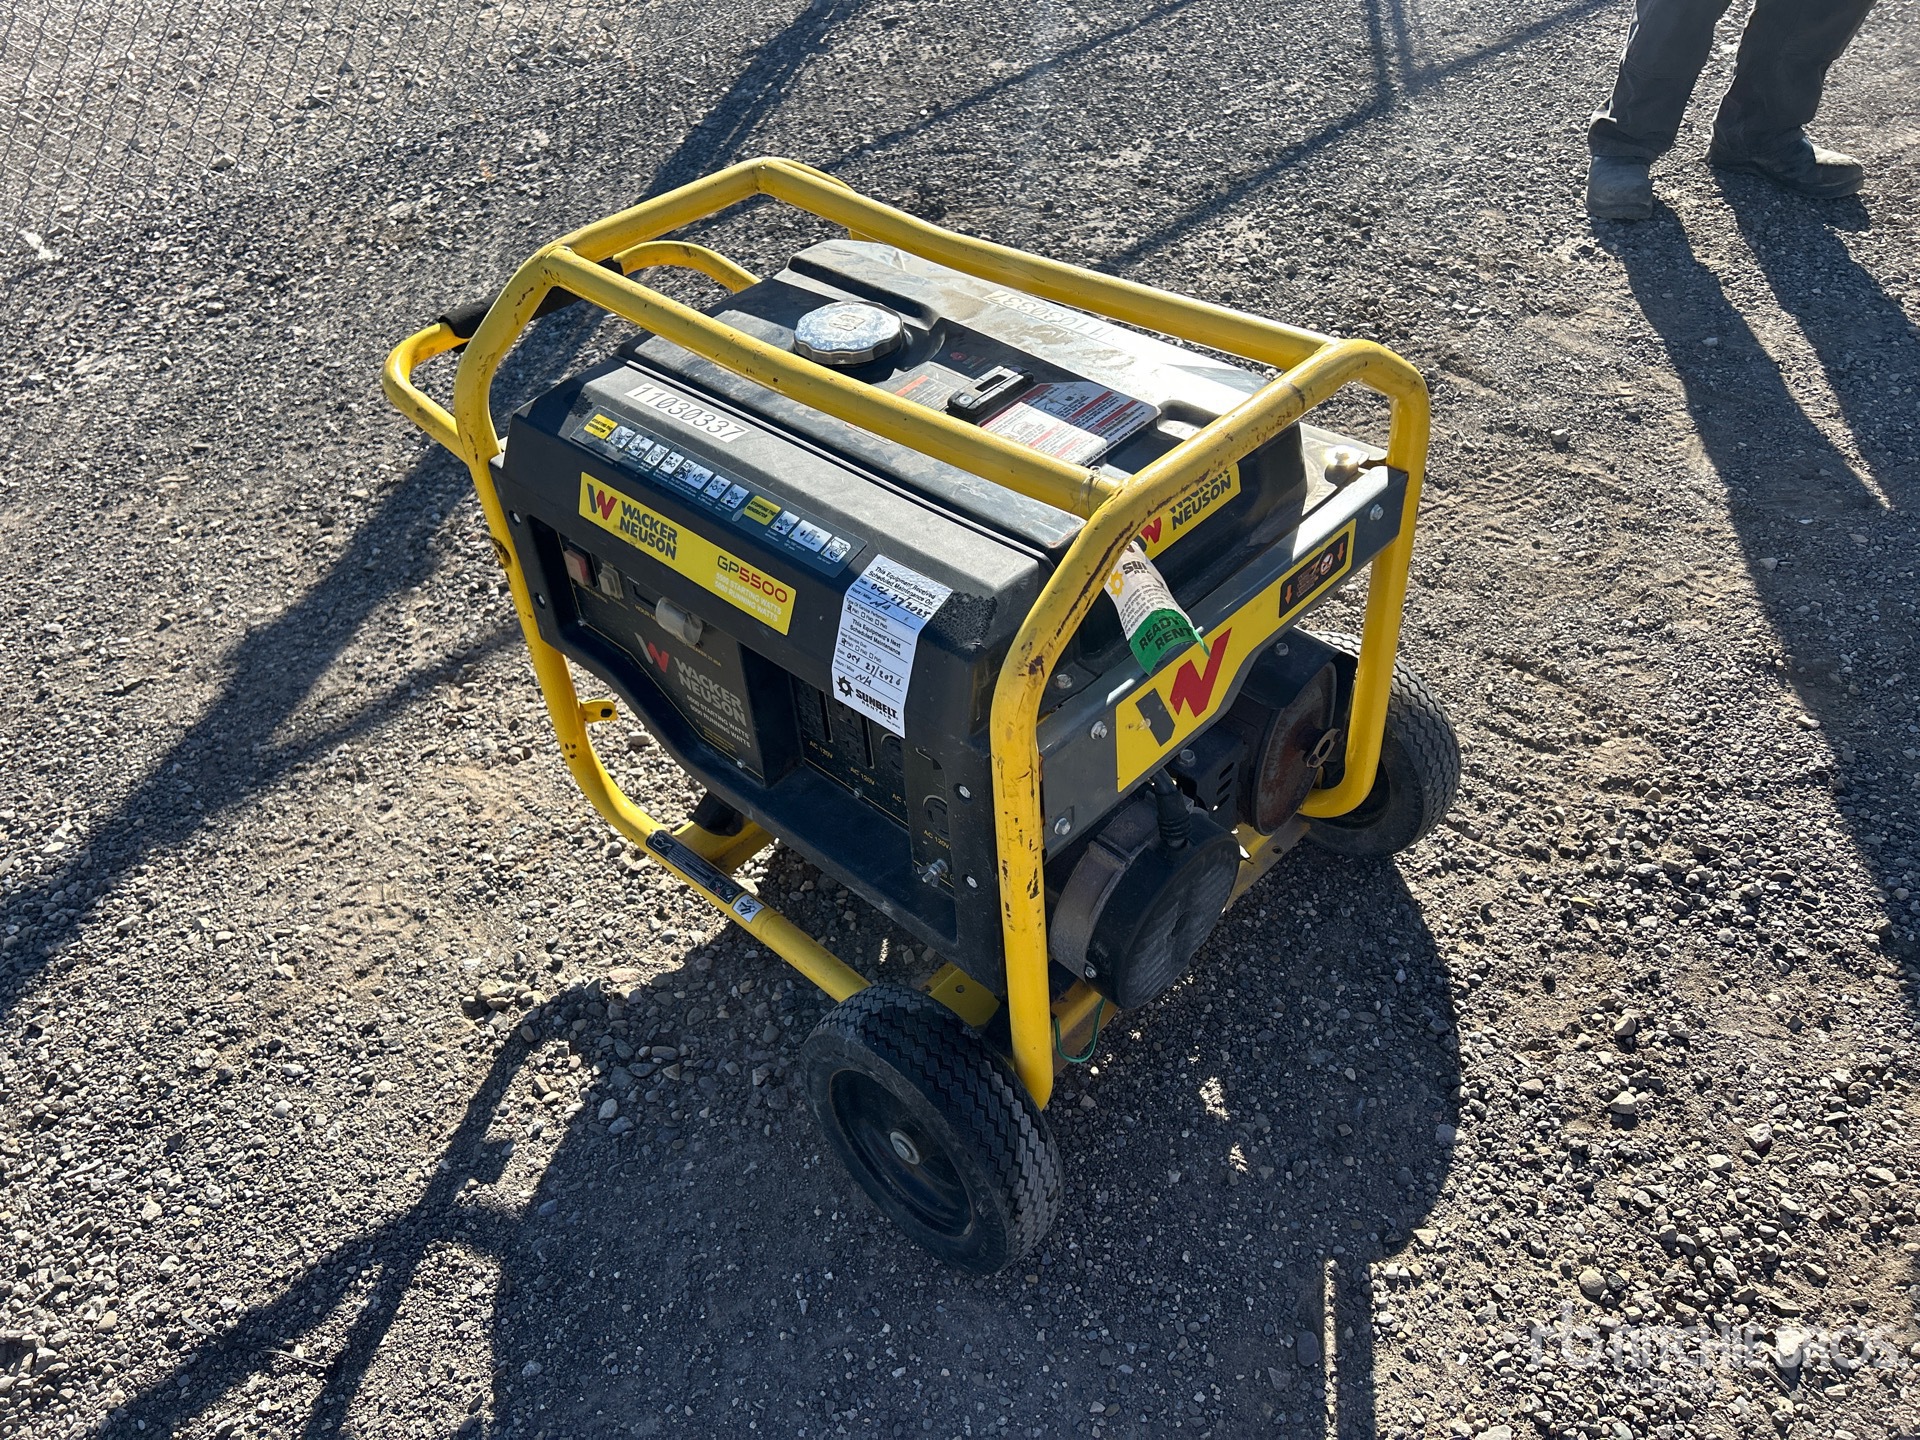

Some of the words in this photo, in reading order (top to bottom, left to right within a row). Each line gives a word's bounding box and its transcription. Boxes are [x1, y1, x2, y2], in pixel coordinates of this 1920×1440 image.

[633, 386, 746, 439] 11030337
[1171, 474, 1231, 531] NEUSON
[619, 515, 678, 561] NEUSON
[621, 500, 678, 546] WACKER
[715, 572, 730, 585] 5500
[729, 580, 761, 604] STARTING
[760, 597, 782, 616] WATTS
[717, 555, 788, 604] GP5500
[868, 570, 895, 588] Scheduled
[893, 582, 927, 603] Maintenance
[875, 566, 886, 575] This
[886, 570, 913, 589] Equipment
[911, 583, 937, 600] Received
[728, 588, 757, 610] RUNNING
[756, 604, 779, 623] WATTS
[849, 624, 874, 641] Scheduled
[872, 636, 902, 656] Maintenance
[852, 618, 863, 629] This
[862, 623, 891, 643] Equipment's
[890, 637, 901, 649] Next
[1138, 616, 1182, 652] READY
[1154, 627, 1193, 651] RENT
[673, 656, 744, 712] WACKER
[678, 671, 747, 728] NEUSON
[700, 702, 729, 726] STARTING
[728, 720, 751, 740] WATTS
[855, 688, 898, 720] SUNBELT
[861, 700, 892, 721] RENTALS
[702, 711, 730, 735] RUNNING
[730, 730, 752, 749] WATTS
[809, 740, 819, 751] AC
[819, 746, 834, 760] 120V
[850, 767, 860, 777] AC
[860, 772, 876, 787] 120V
[923, 829, 934, 839] AC
